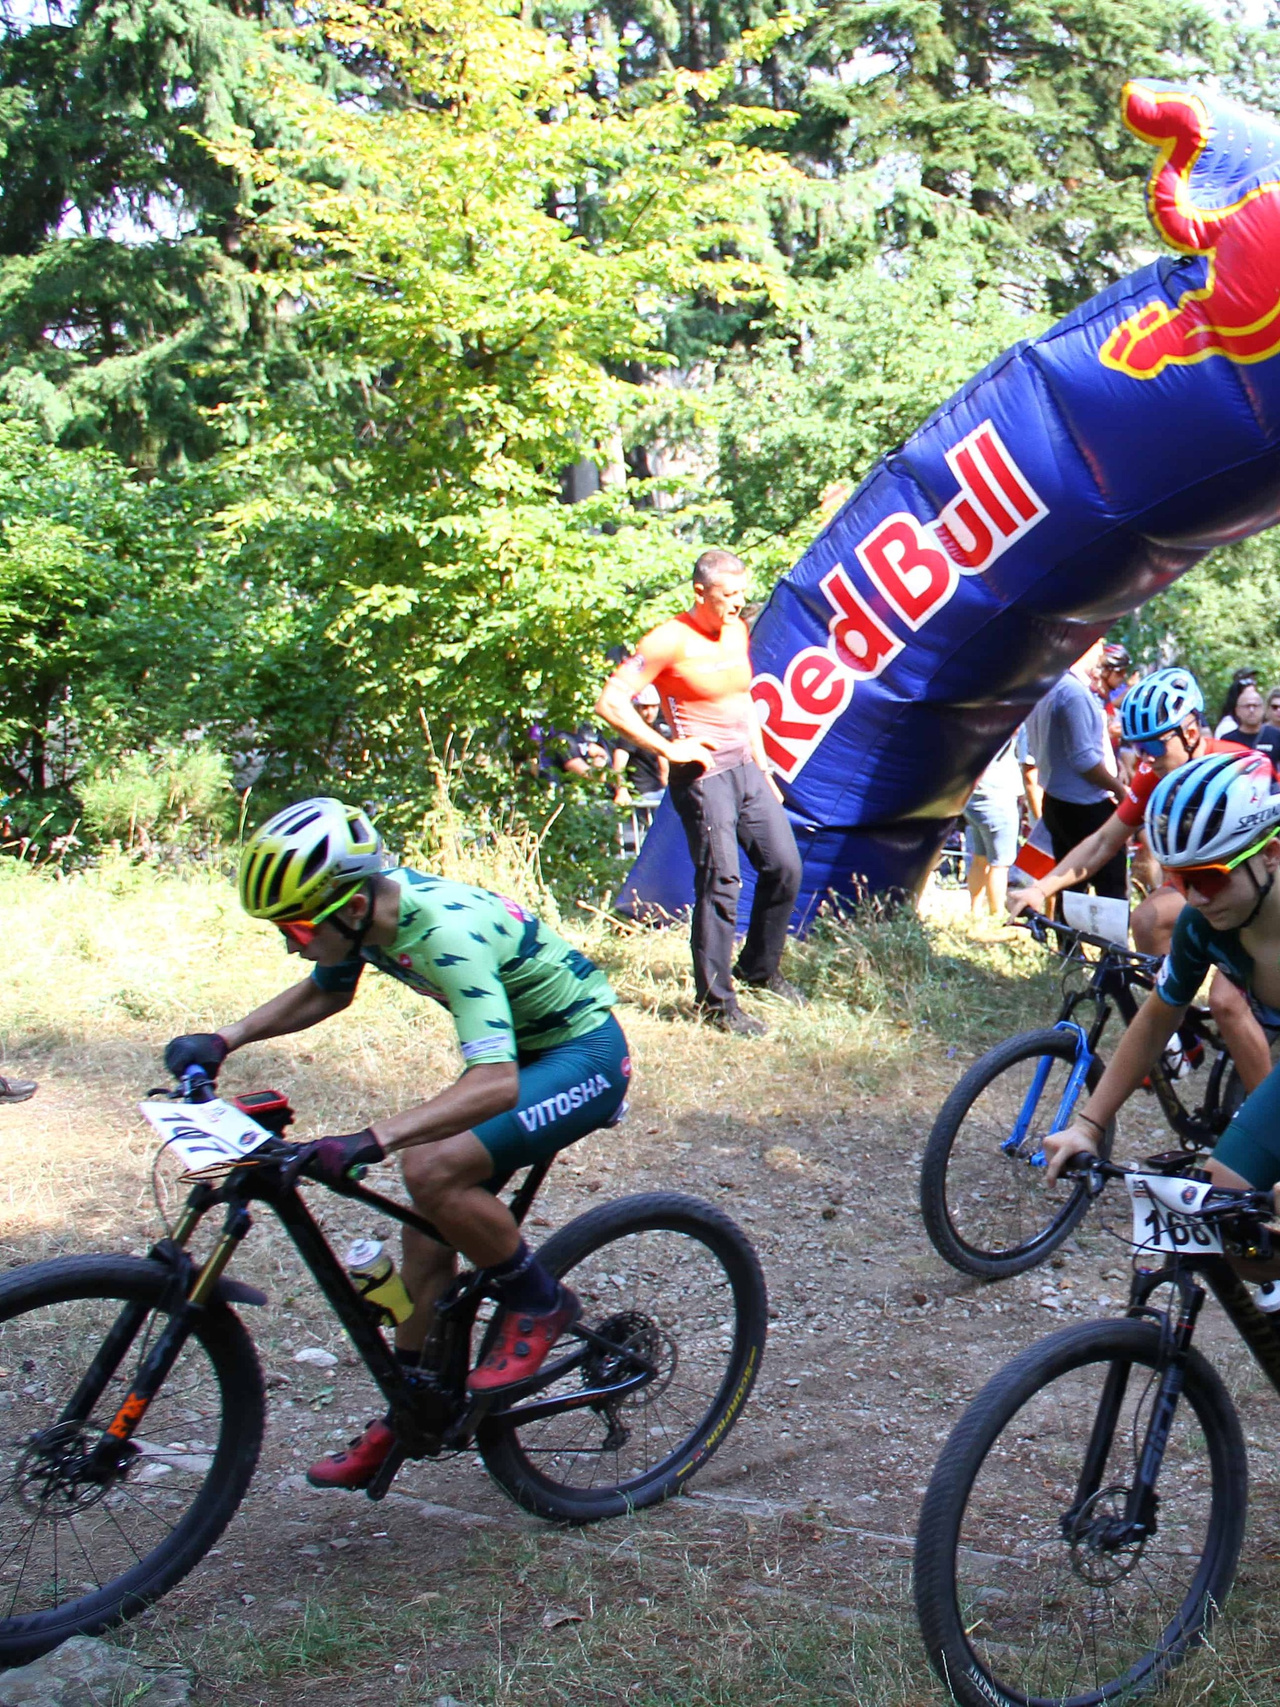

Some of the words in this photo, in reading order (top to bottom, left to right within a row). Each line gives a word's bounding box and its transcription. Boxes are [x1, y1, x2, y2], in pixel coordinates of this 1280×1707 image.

[749, 563, 905, 783] Red
[855, 419, 1050, 632] Bull
[518, 1074, 611, 1132] VITOSHA
[159, 1112, 229, 1154] 107
[106, 1392, 147, 1438] FOX
